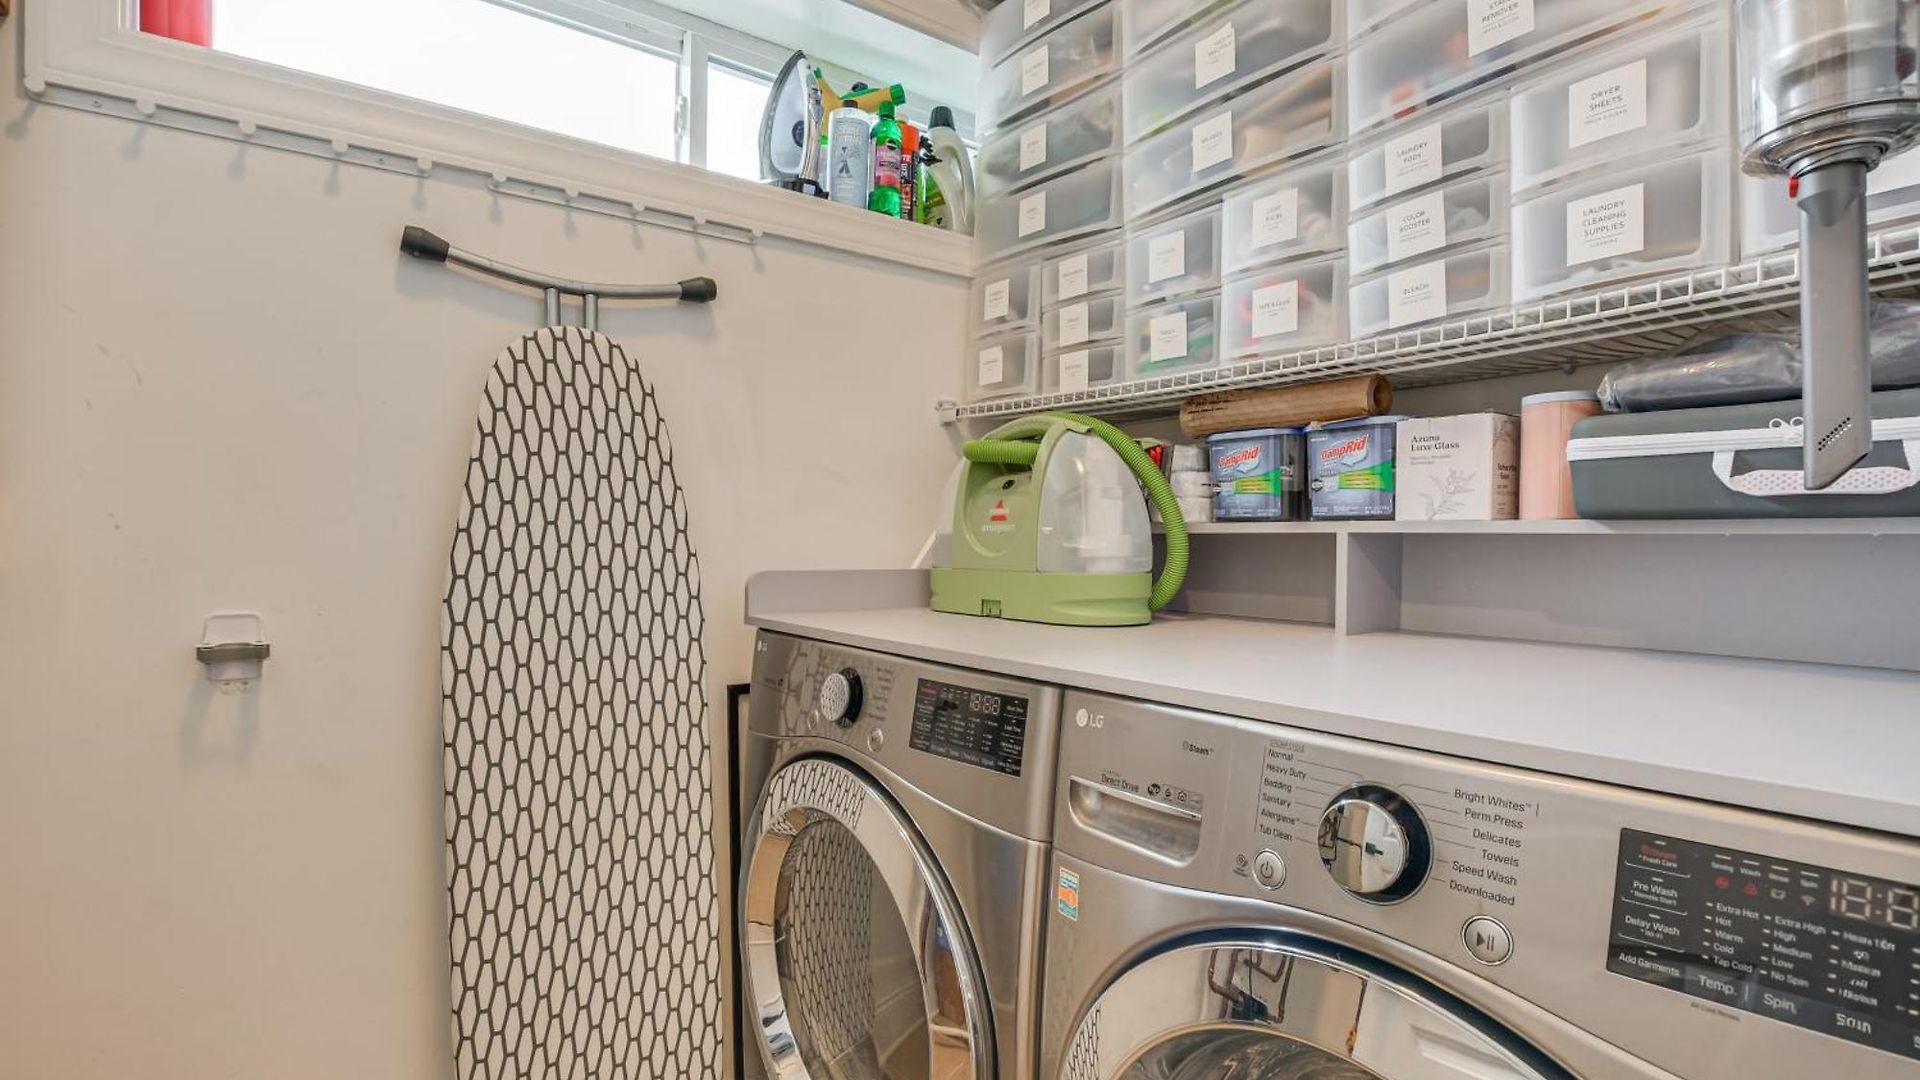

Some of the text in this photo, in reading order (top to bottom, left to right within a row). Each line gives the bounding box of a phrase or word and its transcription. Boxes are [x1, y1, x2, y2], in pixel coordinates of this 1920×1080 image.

[1590, 85, 1621, 101] DRYER
[1588, 95, 1623, 112] SHEETS
[1582, 200, 1625, 217] LAUNDRY
[1582, 210, 1627, 227] CLEANING
[1584, 221, 1625, 238] SUPPLIES
[1434, 441, 1460, 450] Glass
[1089, 714, 1104, 728] LG
[1268, 749, 1293, 761] Normal
[1266, 763, 1306, 780] Heavy Duty
[1264, 777, 1292, 793] Bedding
[1262, 792, 1291, 809] Sanitary
[1454, 788, 1485, 804] Bright
[1260, 824, 1292, 841] Tub Clean
[1472, 828, 1521, 848] Delicates
[1482, 848, 1520, 868] Towels
[1452, 860, 1518, 887] Speed Wash
[1450, 879, 1515, 906] Downloaded
[1633, 880, 1678, 898] Pre Wash
[1716, 902, 1759, 920] Extra Hot
[1625, 914, 1680, 936] Delay Wash
[1715, 915, 1732, 927] Hot
[1775, 915, 1826, 935] Extra High
[1714, 928, 1744, 943] Warm
[1774, 929, 1797, 942] High
[1713, 942, 1735, 955] Cold
[1773, 943, 1813, 961] Medium
[1619, 952, 1680, 977] Add Garments
[1714, 955, 1753, 974] Tap Cold
[1772, 956, 1795, 970] Low
